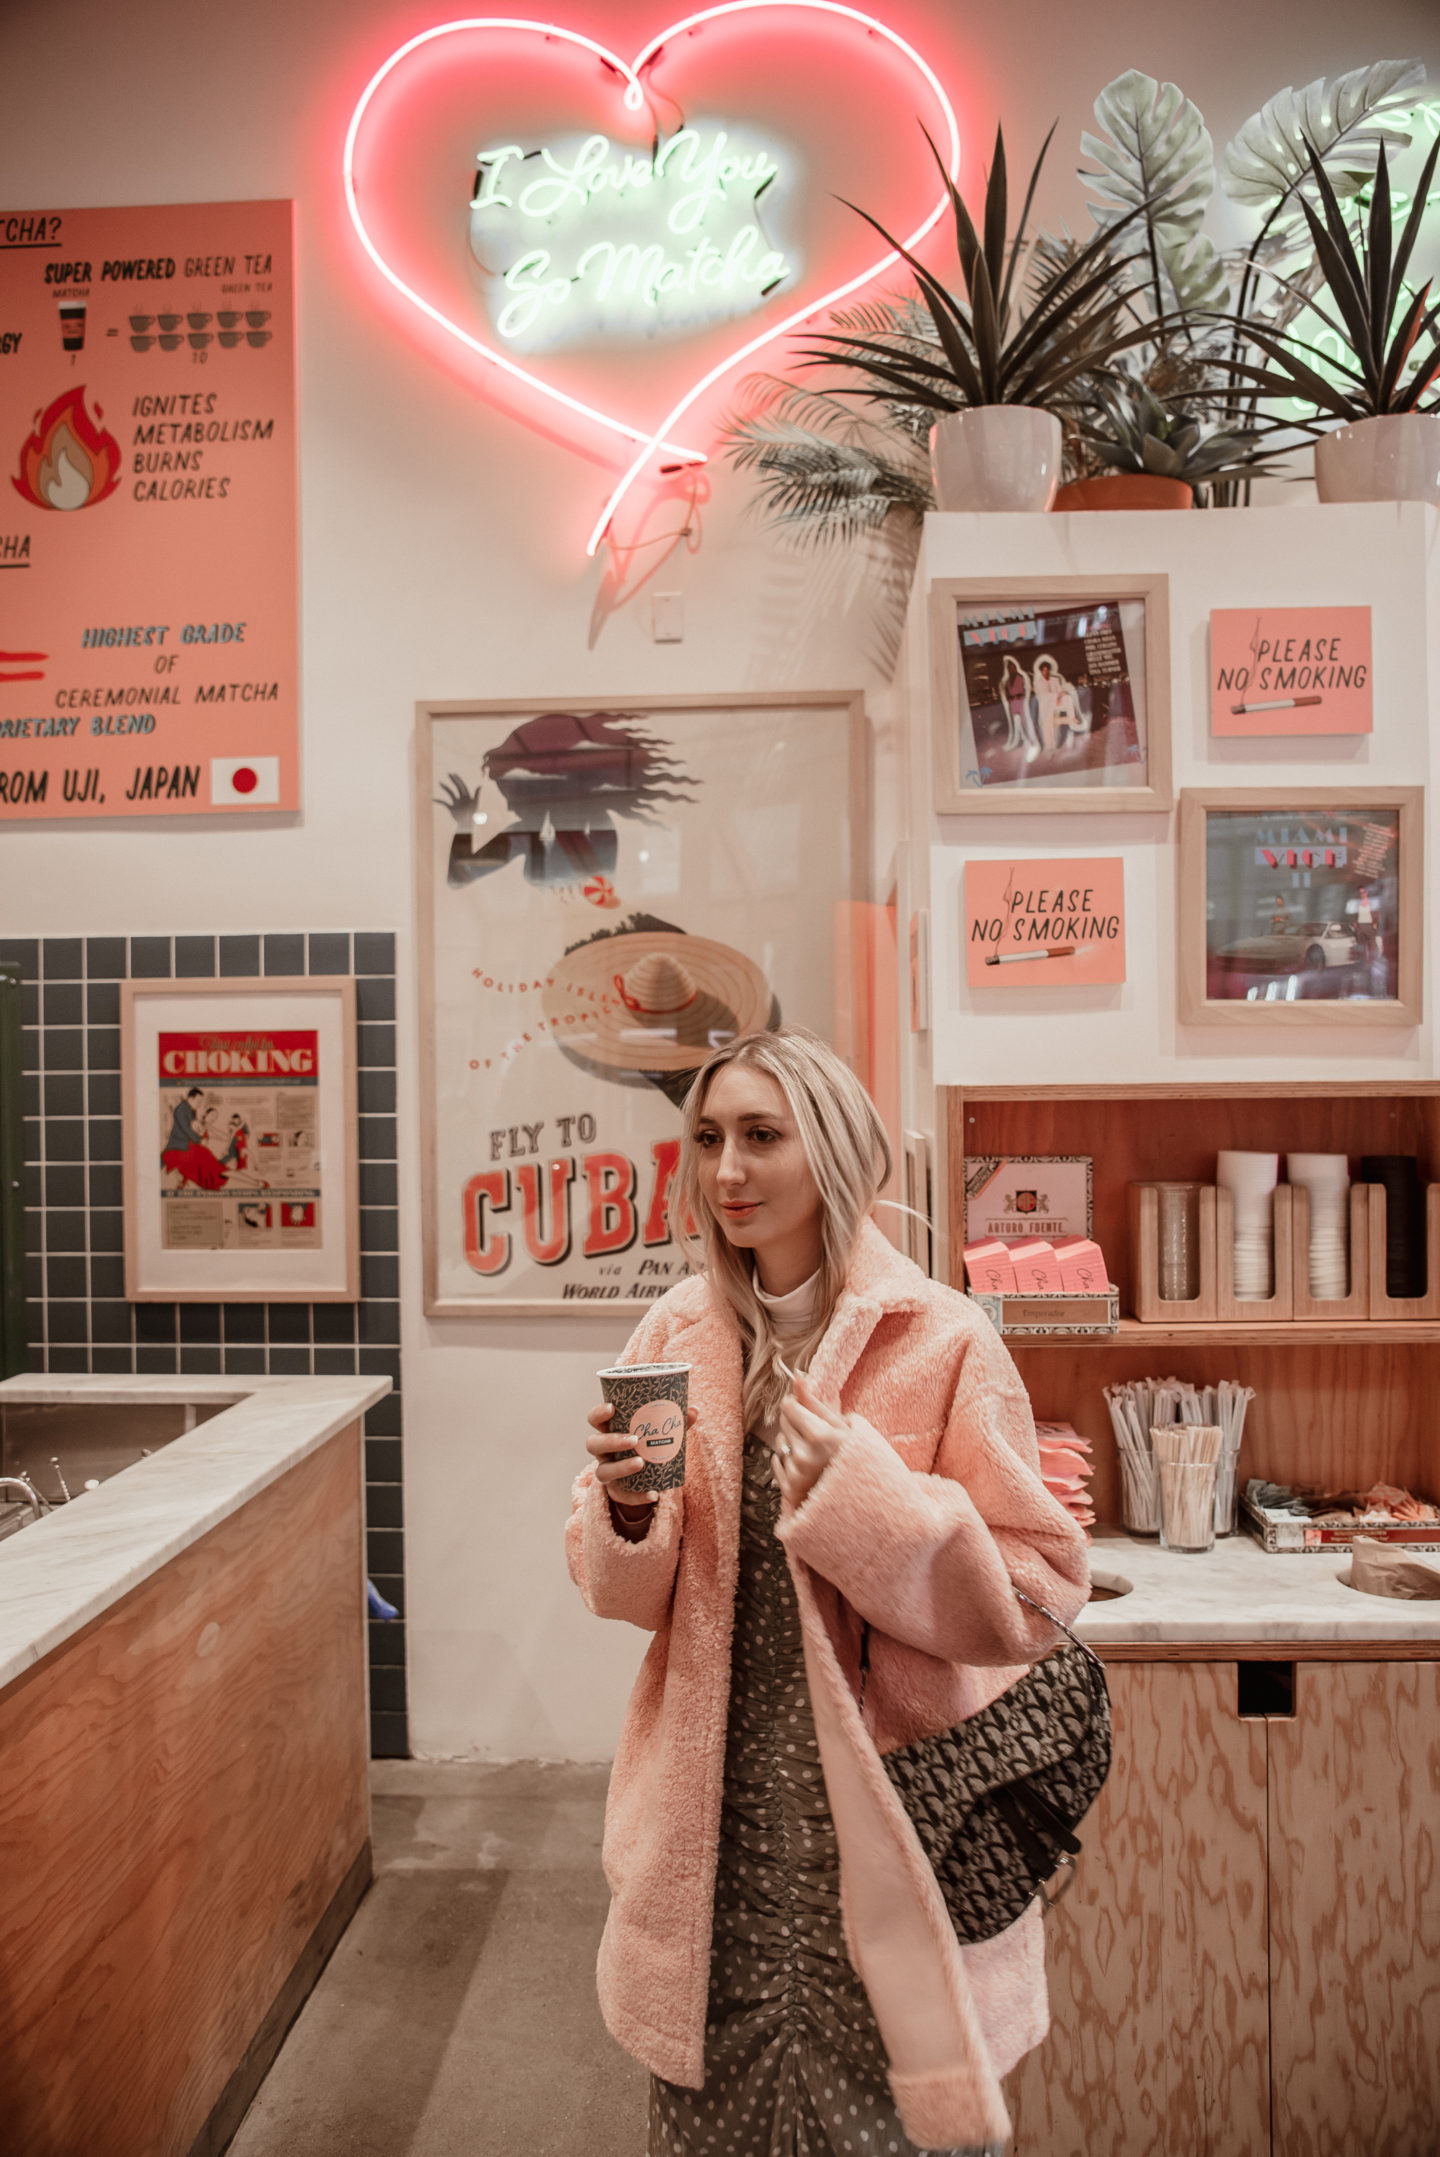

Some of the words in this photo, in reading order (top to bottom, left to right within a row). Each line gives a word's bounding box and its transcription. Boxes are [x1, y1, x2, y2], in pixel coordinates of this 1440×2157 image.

[470, 145, 524, 209] I
[519, 134, 653, 217] Love
[654, 130, 778, 234] You
[0, 217, 62, 242] CHA?
[44, 261, 92, 284] SUPER
[101, 257, 175, 281] POWERED
[184, 256, 235, 278] GREEN
[244, 254, 272, 275] TEA
[576, 225, 791, 307] Matcha
[52, 288, 90, 298] MATCHA
[221, 283, 250, 294] GREEN
[255, 282, 273, 293] TEA
[0, 333, 22, 354] GY
[132, 393, 217, 417] IGNITES
[132, 419, 274, 446] METABOLISM
[133, 450, 203, 474] BURNS
[133, 478, 230, 502] CALORIES
[0, 535, 31, 559] HA
[81, 626, 169, 649] HIGHEST
[180, 623, 247, 645] GRADE
[1257, 638, 1341, 662] PLEASE
[154, 654, 180, 675] OF
[1217, 667, 1249, 691] NO
[1259, 665, 1367, 690] SMOKING
[55, 686, 182, 708] CEREMONIAL
[195, 682, 279, 705] MATCHA
[0, 716, 80, 738] RIETARY
[90, 714, 156, 736] BLEND
[62, 767, 105, 804] UJI,
[126, 765, 201, 800] JAPAN
[1256, 827, 1347, 844] MIAMI
[1011, 889, 1093, 913] PLEASE
[971, 918, 1003, 942] NO
[1013, 916, 1120, 942] SMOKING
[472, 968, 554, 993] HOLIDAY
[163, 1049, 313, 1074] CHOKING
[490, 1122, 544, 1161] FLY
[557, 1113, 597, 1148] TO
[988, 1222, 1023, 1234] ARTURO
[1029, 1222, 1063, 1234] FUENTE
[599, 1264, 622, 1276] via
[638, 1259, 673, 1276] PAN
[562, 1283, 621, 1299] WORLD
